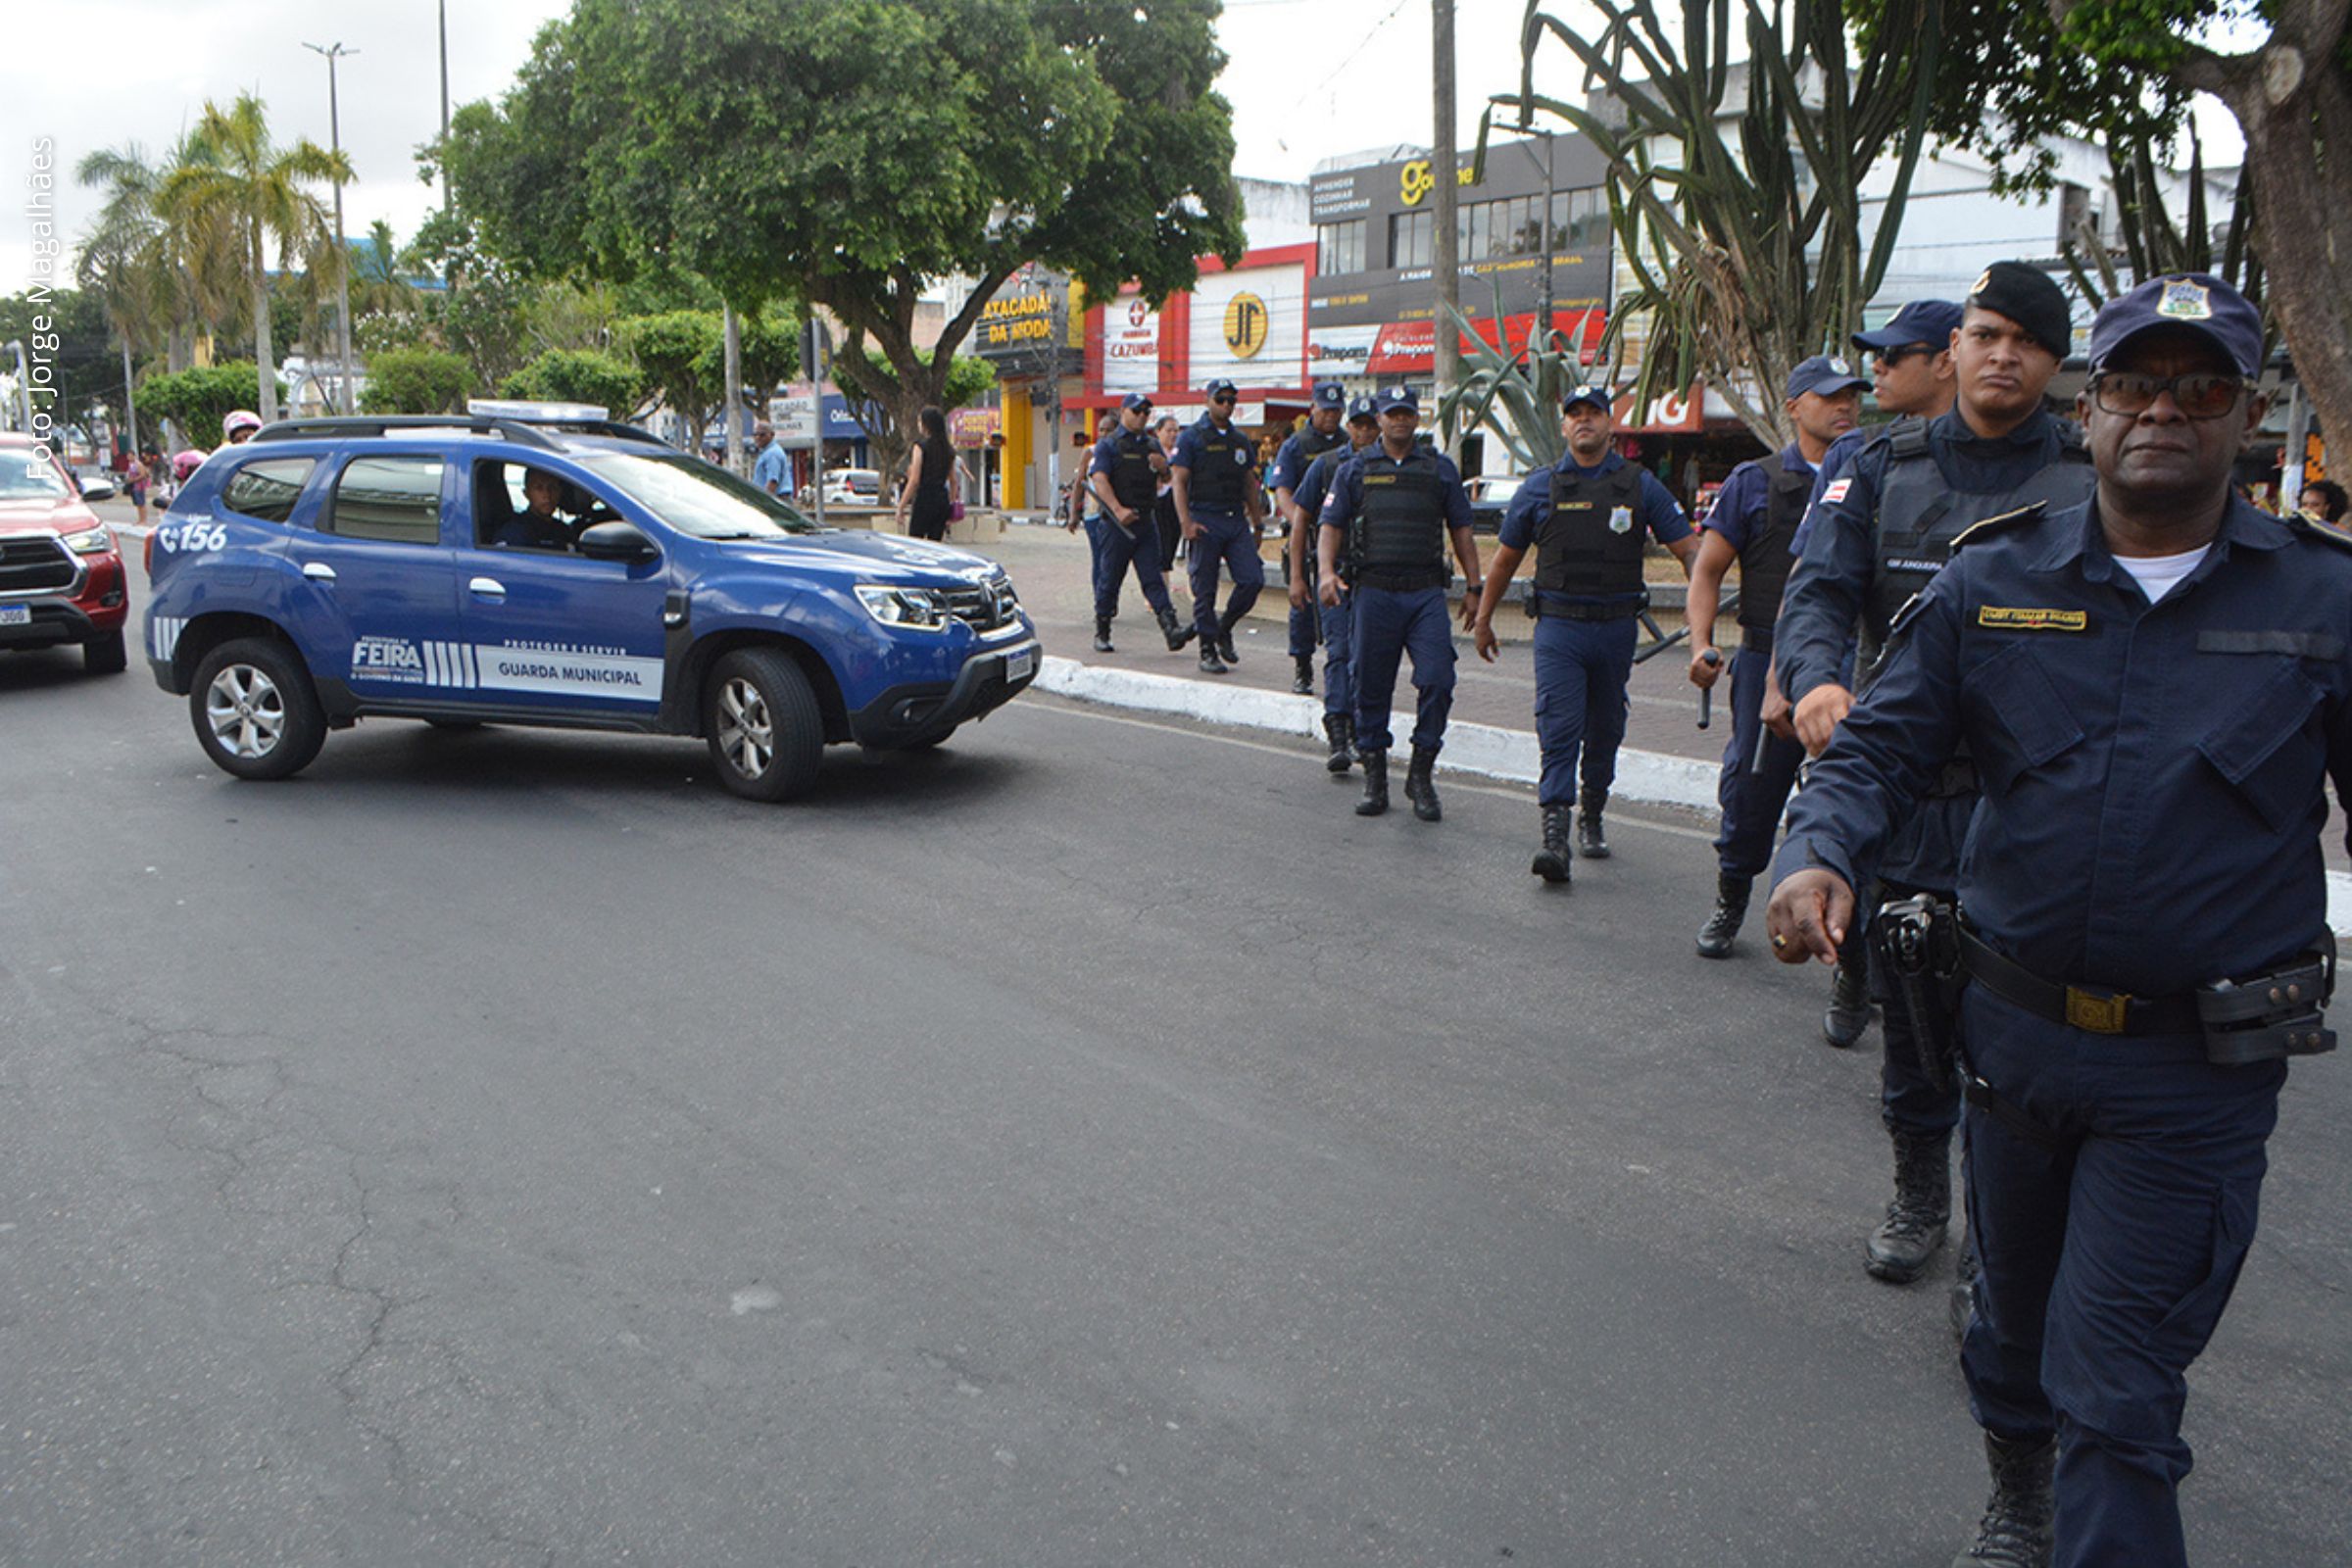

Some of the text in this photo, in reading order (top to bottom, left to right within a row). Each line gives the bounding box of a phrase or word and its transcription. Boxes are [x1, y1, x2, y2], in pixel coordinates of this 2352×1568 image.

[989, 324, 1008, 343] DA
[180, 523, 228, 551] 156
[353, 642, 422, 667] FEIRA
[505, 639, 568, 652] PROTEGER
[581, 645, 627, 657] SERVIR
[498, 662, 642, 686] GUARDA MUNICIPAL
